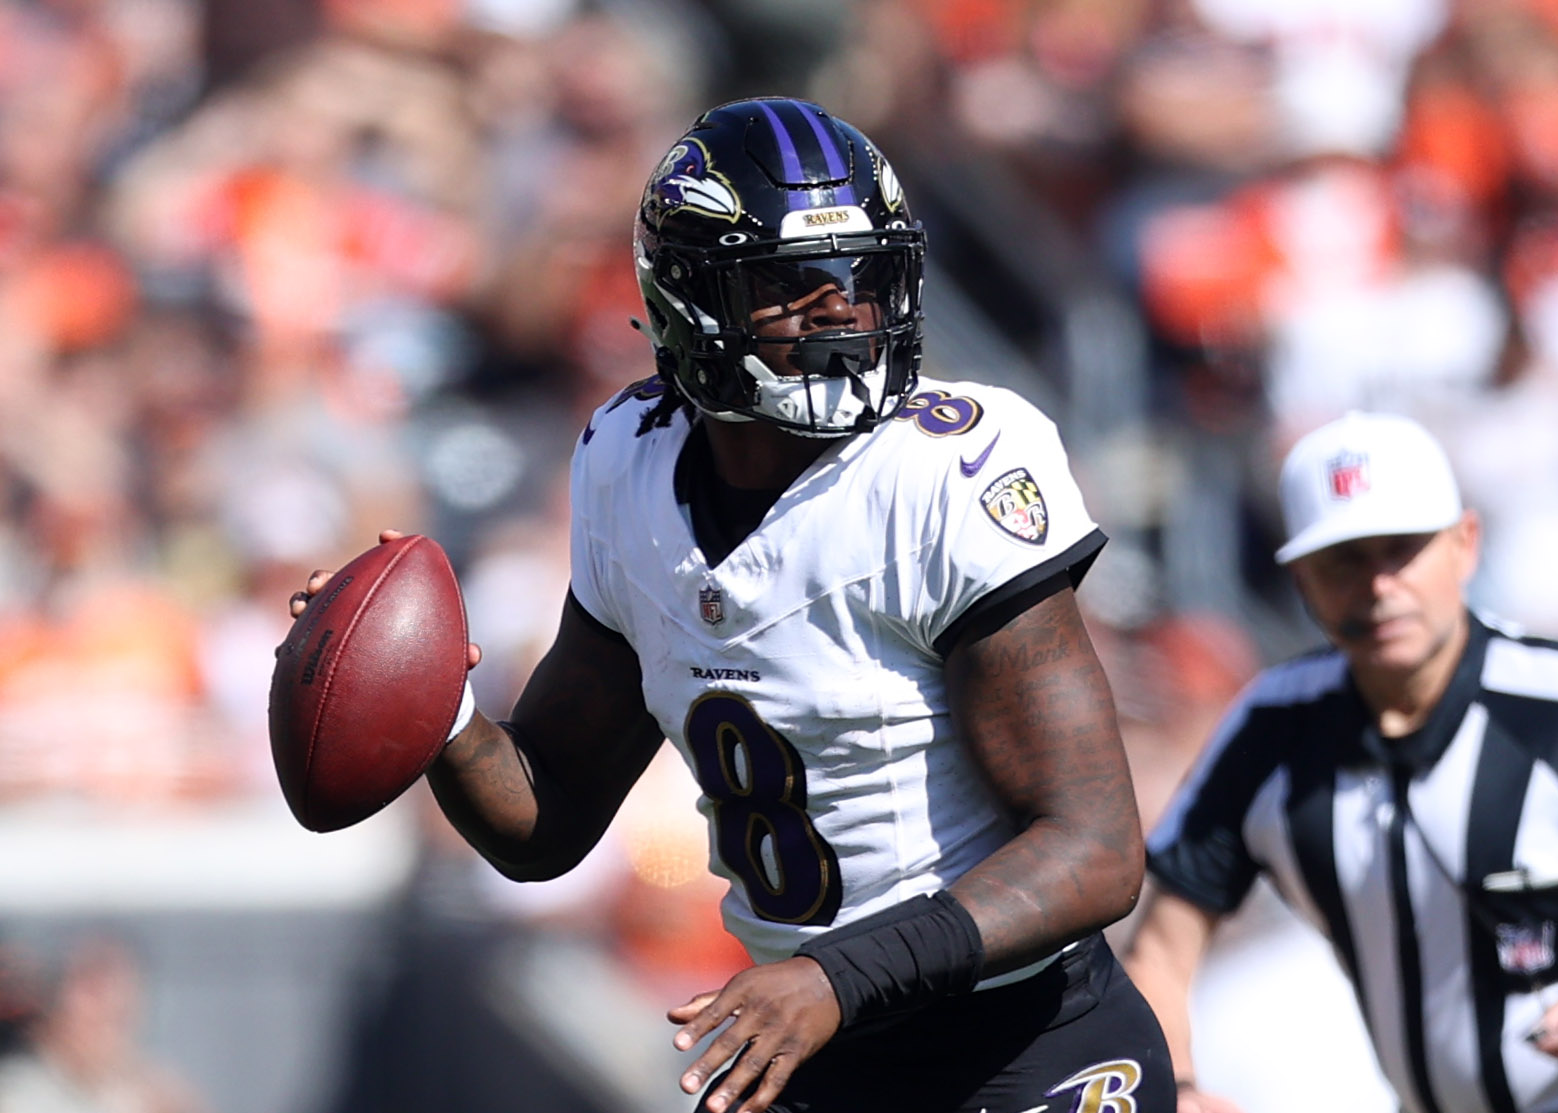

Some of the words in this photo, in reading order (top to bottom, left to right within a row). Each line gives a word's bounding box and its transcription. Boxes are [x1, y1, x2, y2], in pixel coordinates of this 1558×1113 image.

[803, 211, 849, 227] RAVENS
[893, 390, 985, 438] 8
[690, 667, 761, 682] RAVENS
[683, 690, 843, 926] 8
